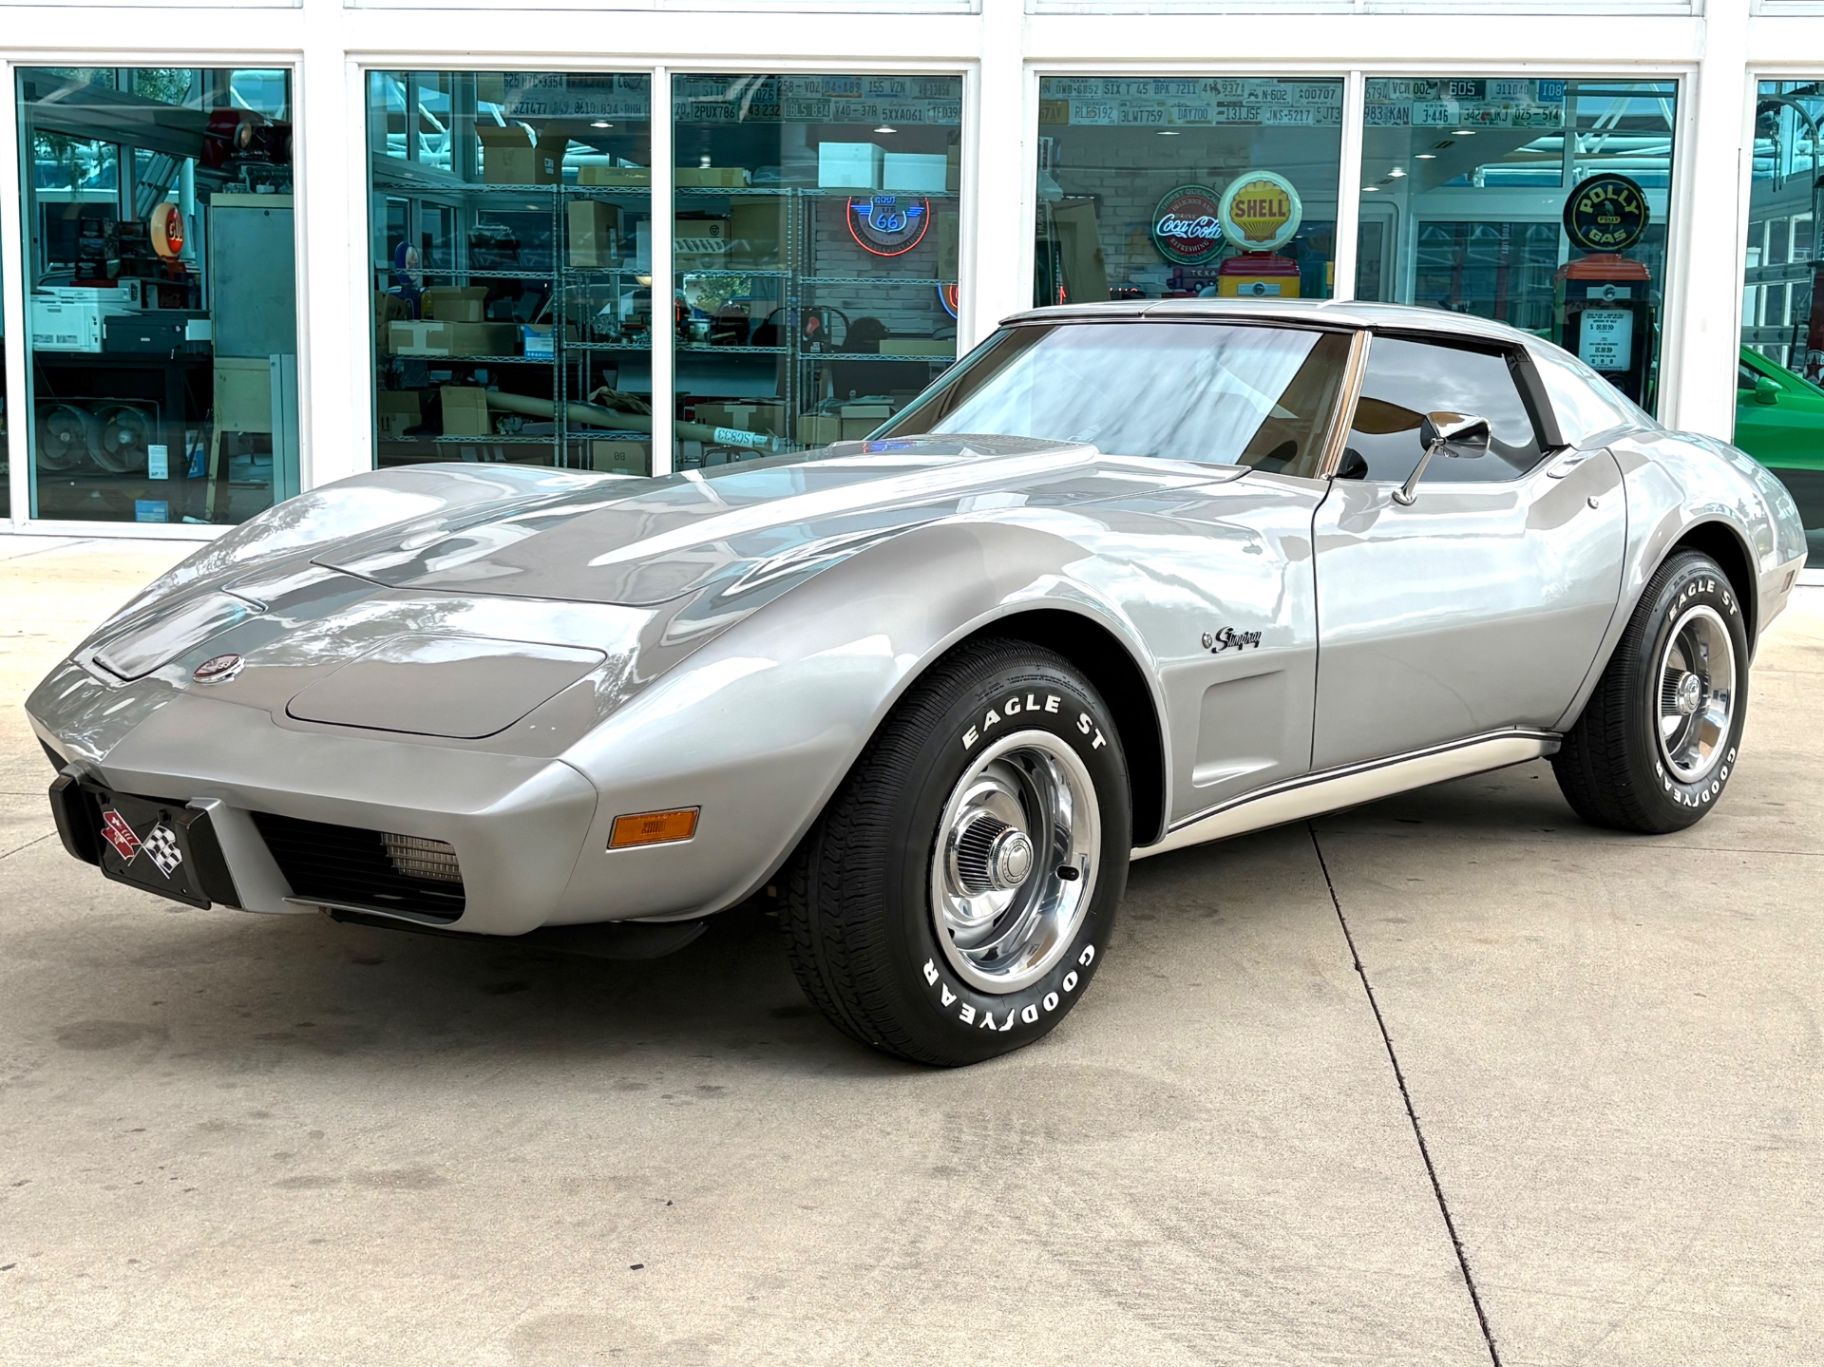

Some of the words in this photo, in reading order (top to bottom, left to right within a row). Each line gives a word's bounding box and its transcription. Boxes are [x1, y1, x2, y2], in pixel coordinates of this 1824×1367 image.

[1235, 199, 1286, 218] SHELL
[1579, 184, 1639, 215] POLLY
[876, 213, 898, 229] 66
[1157, 213, 1222, 239] Coca-Cola
[1588, 229, 1628, 244] GAS
[1668, 579, 1715, 622] EAGLE
[1721, 590, 1738, 616] ST
[961, 693, 1061, 751] EAGLE
[1076, 712, 1107, 751] ST
[1655, 746, 1736, 808] GOODYEAR
[922, 943, 1096, 1032] GOODYEAR
